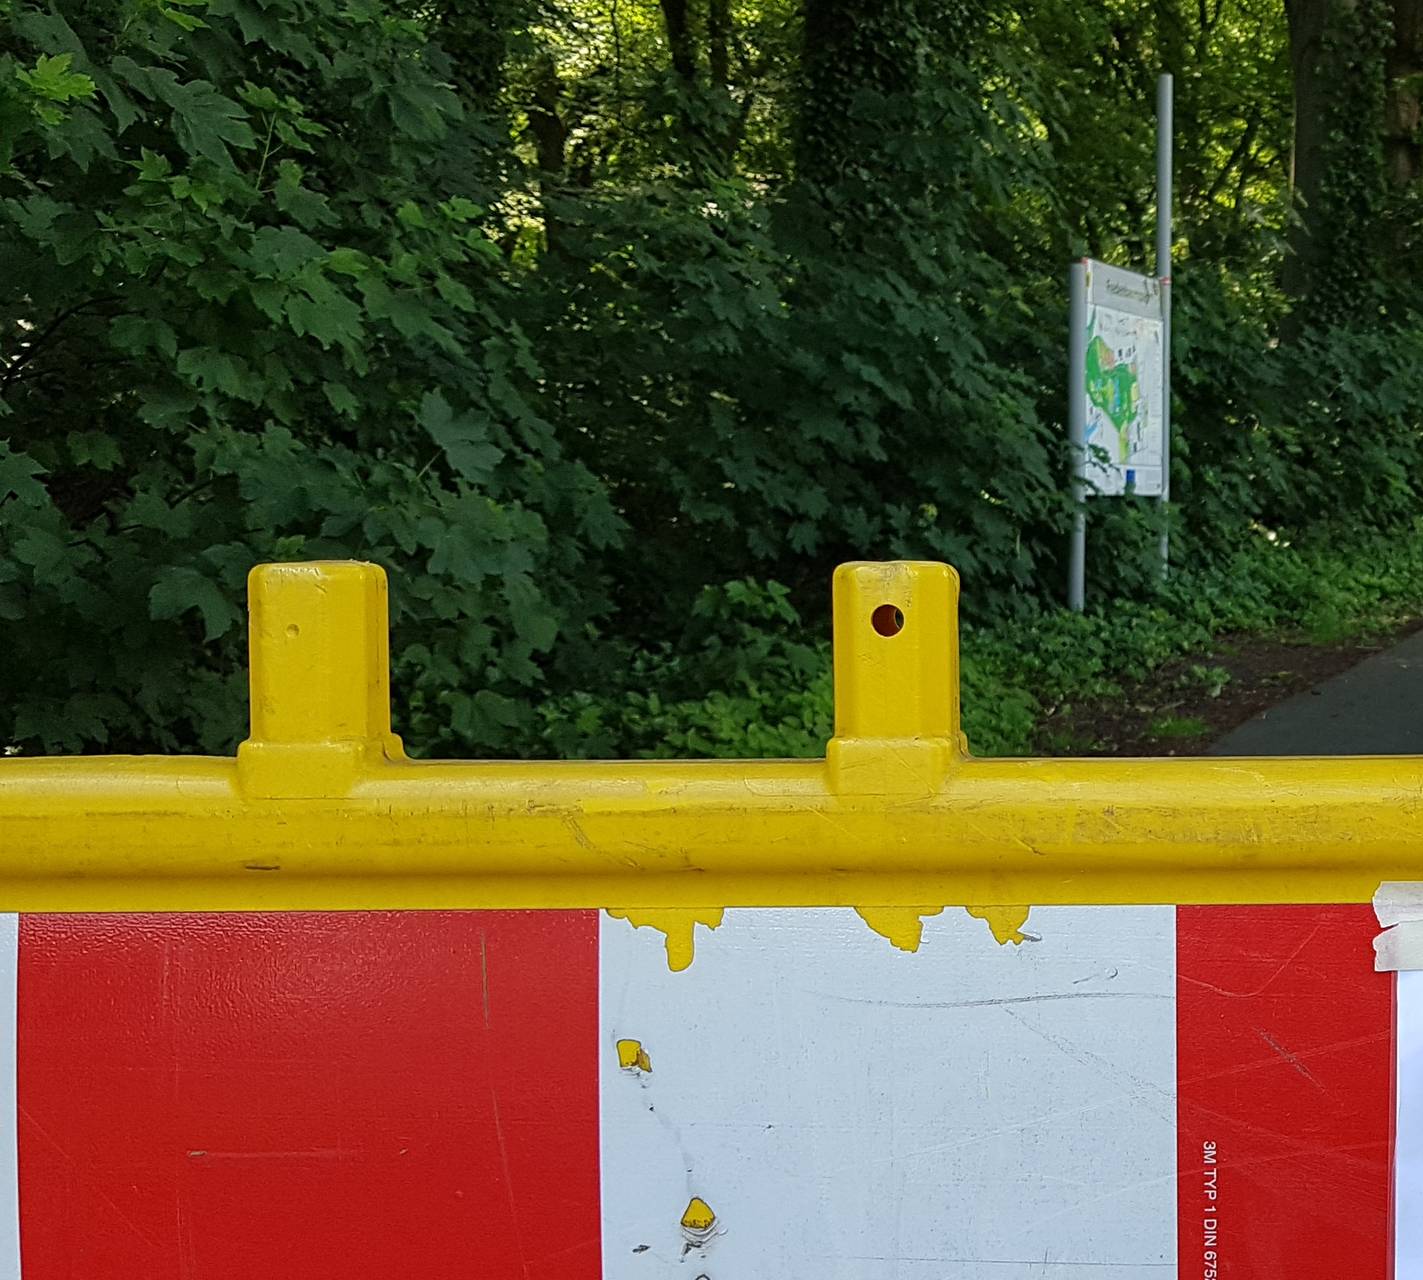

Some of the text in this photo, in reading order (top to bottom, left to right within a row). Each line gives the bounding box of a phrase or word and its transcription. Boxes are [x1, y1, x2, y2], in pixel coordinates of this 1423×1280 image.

[1202, 1140, 1217, 1164] 3M
[1203, 1167, 1217, 1200] TYP
[1203, 1218, 1217, 1247] DIN
